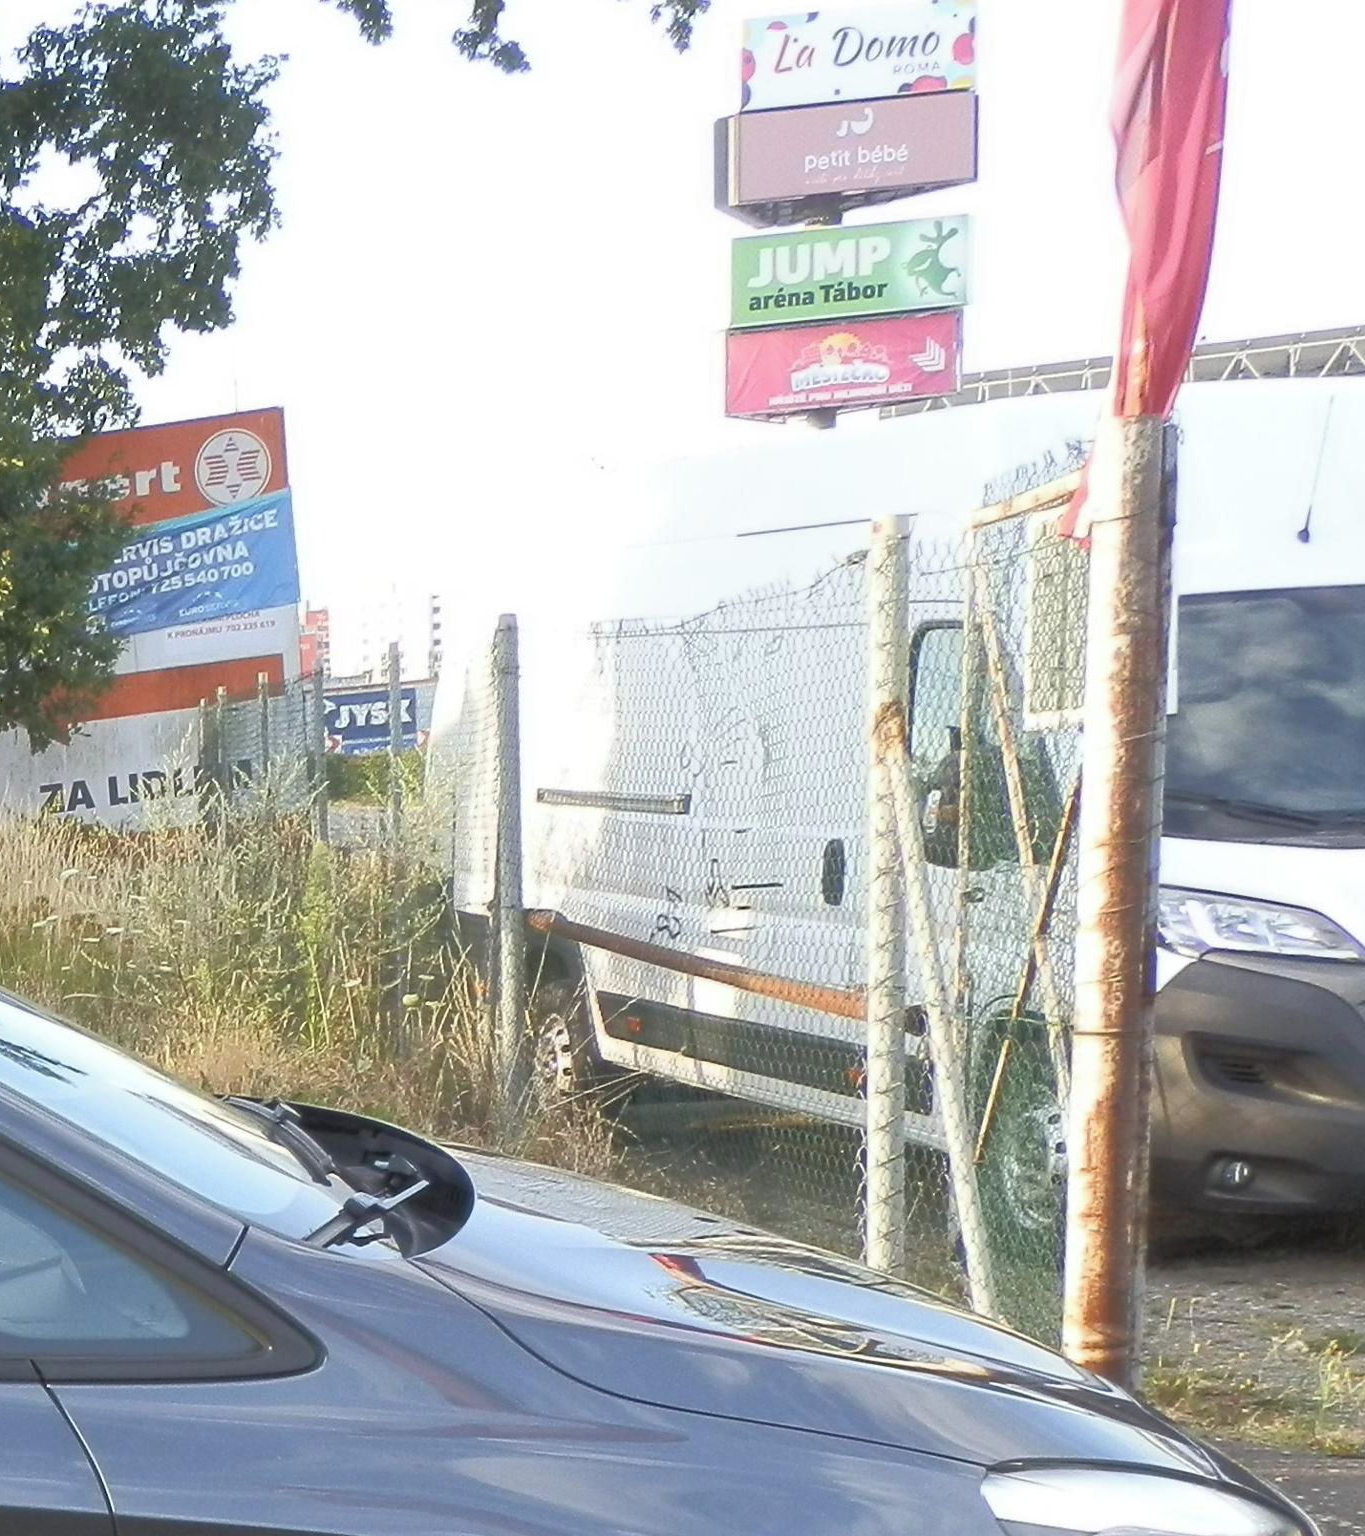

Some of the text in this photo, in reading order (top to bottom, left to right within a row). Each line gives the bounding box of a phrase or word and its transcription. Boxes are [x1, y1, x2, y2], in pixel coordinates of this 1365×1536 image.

[774, 26, 941, 73] La Domo
[893, 61, 941, 75] ROMA
[804, 144, 909, 173] petit bébé
[747, 236, 891, 288] JUMP
[749, 281, 888, 311] aréna Tábor
[181, 508, 278, 549] DRAŽICE
